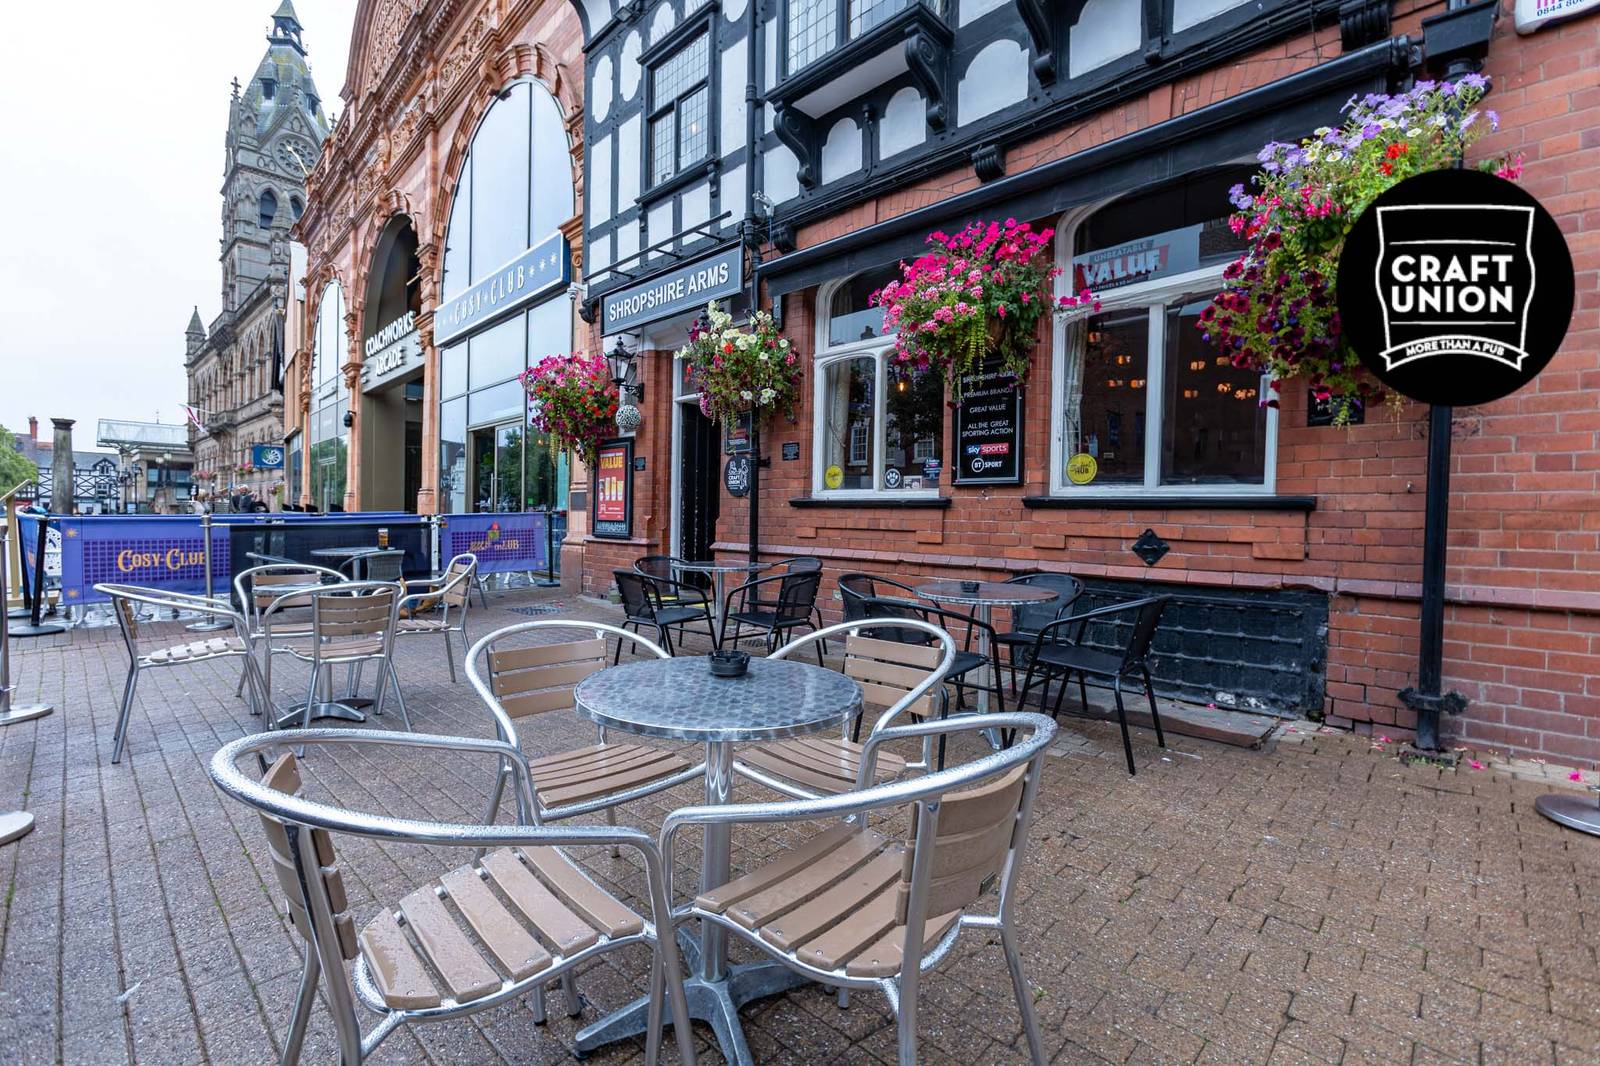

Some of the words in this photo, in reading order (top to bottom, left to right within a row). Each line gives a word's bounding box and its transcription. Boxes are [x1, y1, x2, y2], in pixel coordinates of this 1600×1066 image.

[1536, 3, 1562, 17] 0844
[455, 290, 482, 325] COSY
[490, 265, 525, 305] CLUB
[609, 278, 685, 322] SHROPSHIRE
[687, 262, 729, 296] ARMS
[365, 310, 415, 357] COACHWORKS
[375, 346, 403, 376] ARCADE
[969, 406, 987, 414] GREAT
[988, 404, 1006, 412] VALUE
[990, 420, 1008, 428] GREAT
[962, 429, 990, 438] SPORTING
[990, 428, 1014, 436] ACTION
[967, 444, 980, 455] sky
[981, 444, 1007, 454] sports
[600, 455, 623, 469] VALUE
[984, 460, 1002, 468] SPORT
[117, 549, 161, 572] COSY
